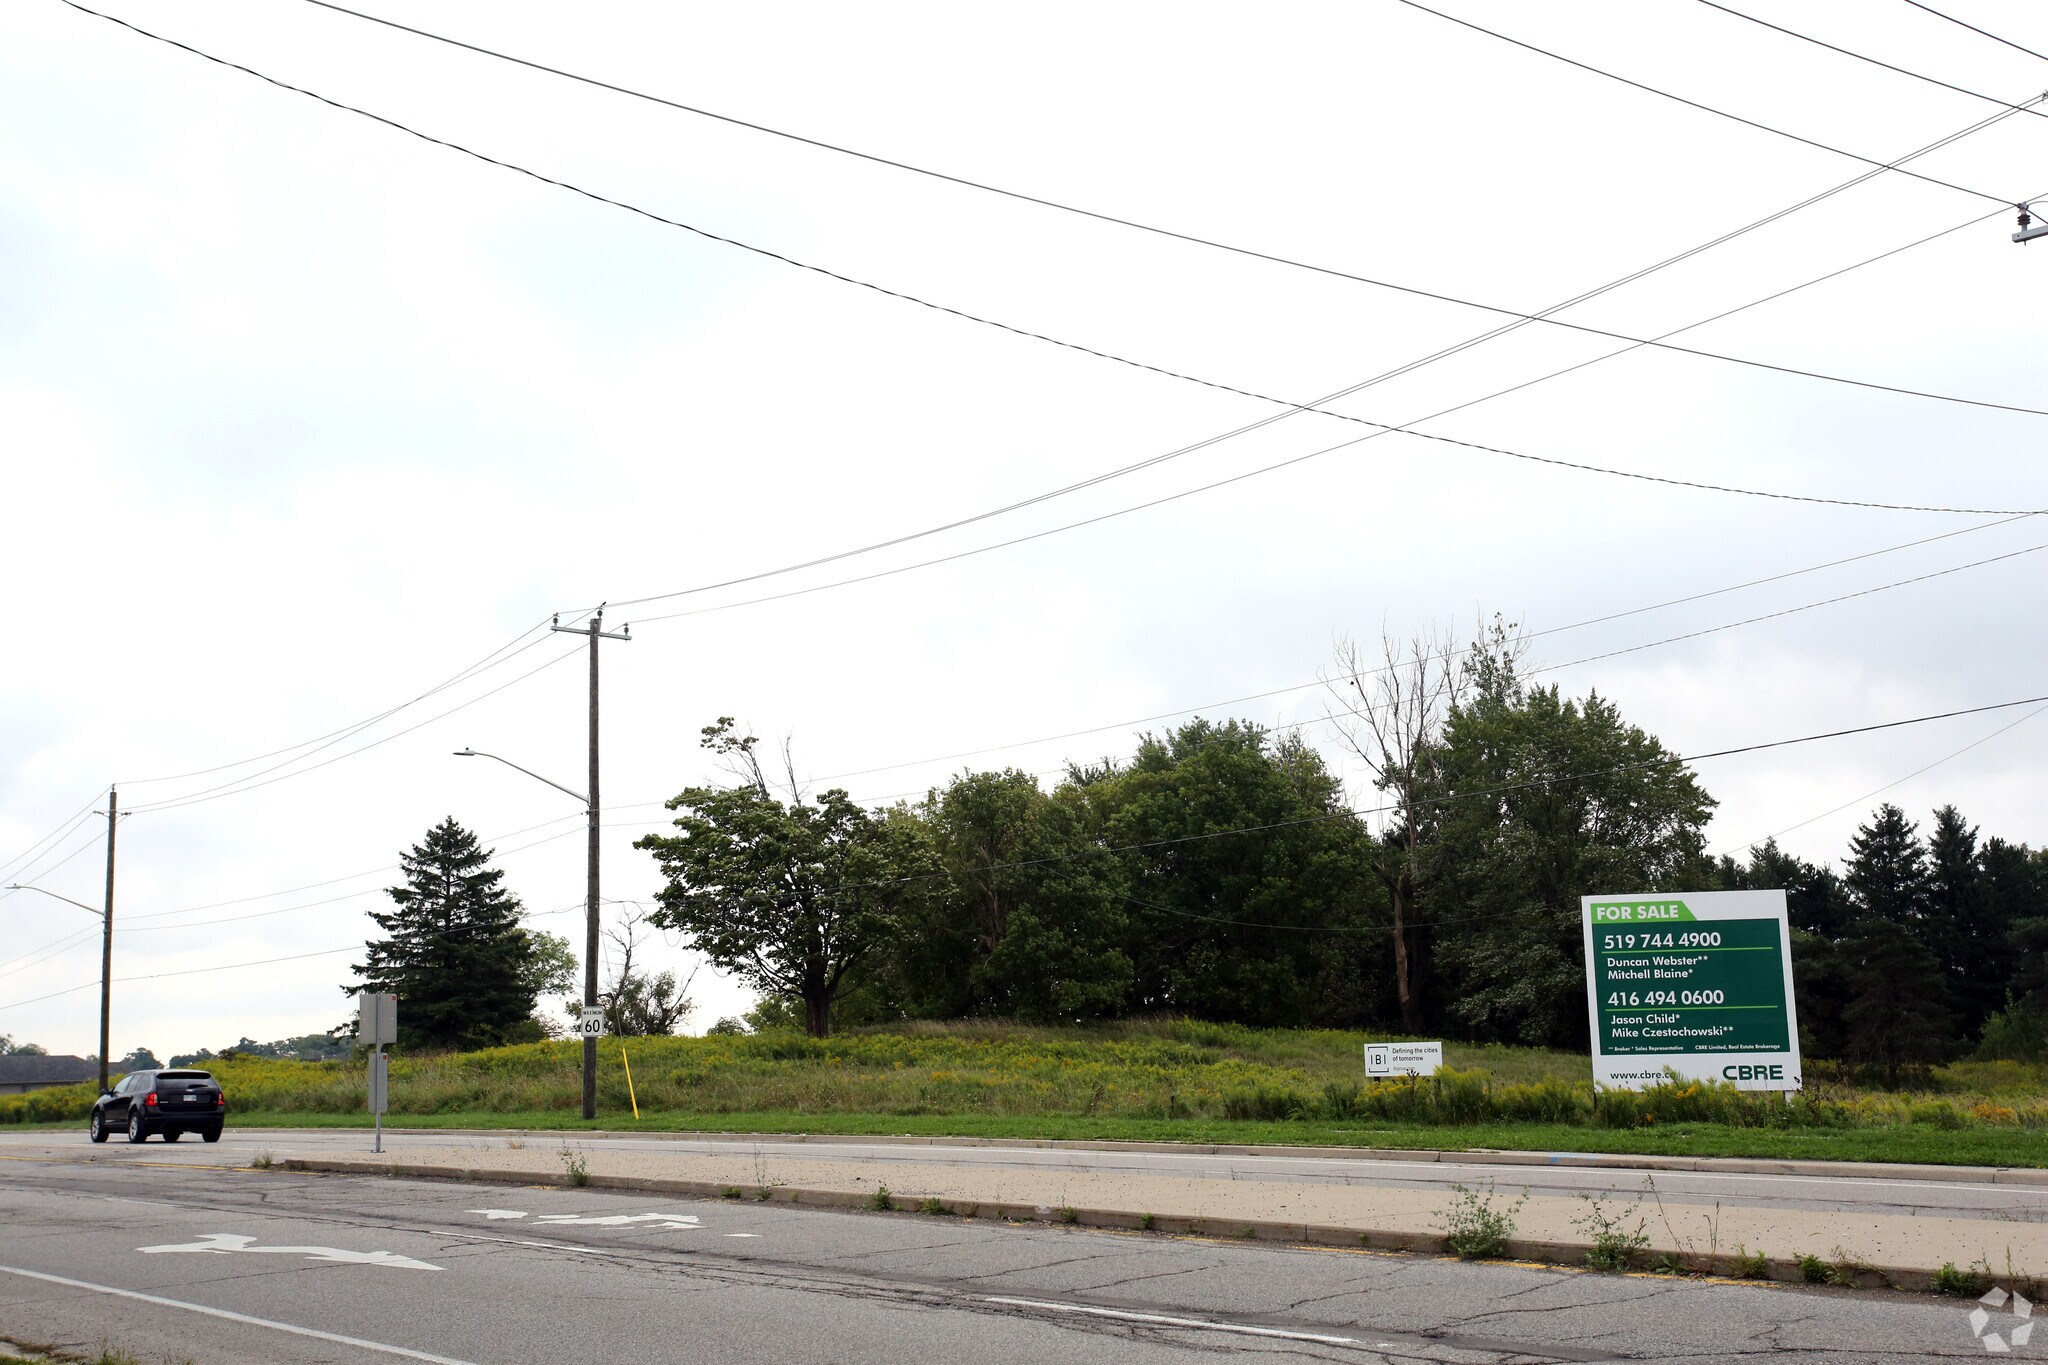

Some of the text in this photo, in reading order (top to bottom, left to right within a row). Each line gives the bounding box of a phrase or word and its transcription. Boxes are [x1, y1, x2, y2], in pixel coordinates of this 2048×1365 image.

[1596, 905, 1679, 920] FOR SALE
[1604, 932, 1721, 949] 519 744 4900
[1607, 957, 1649, 967] Duncan
[1608, 969, 1650, 980] Mitchell
[1608, 990, 1724, 1006] 416 494 0600
[585, 1020, 600, 1032] 60
[1611, 1015, 1643, 1025] Jason
[1612, 1028, 1639, 1038] Mike
[1723, 1065, 1783, 1080] CBRE
